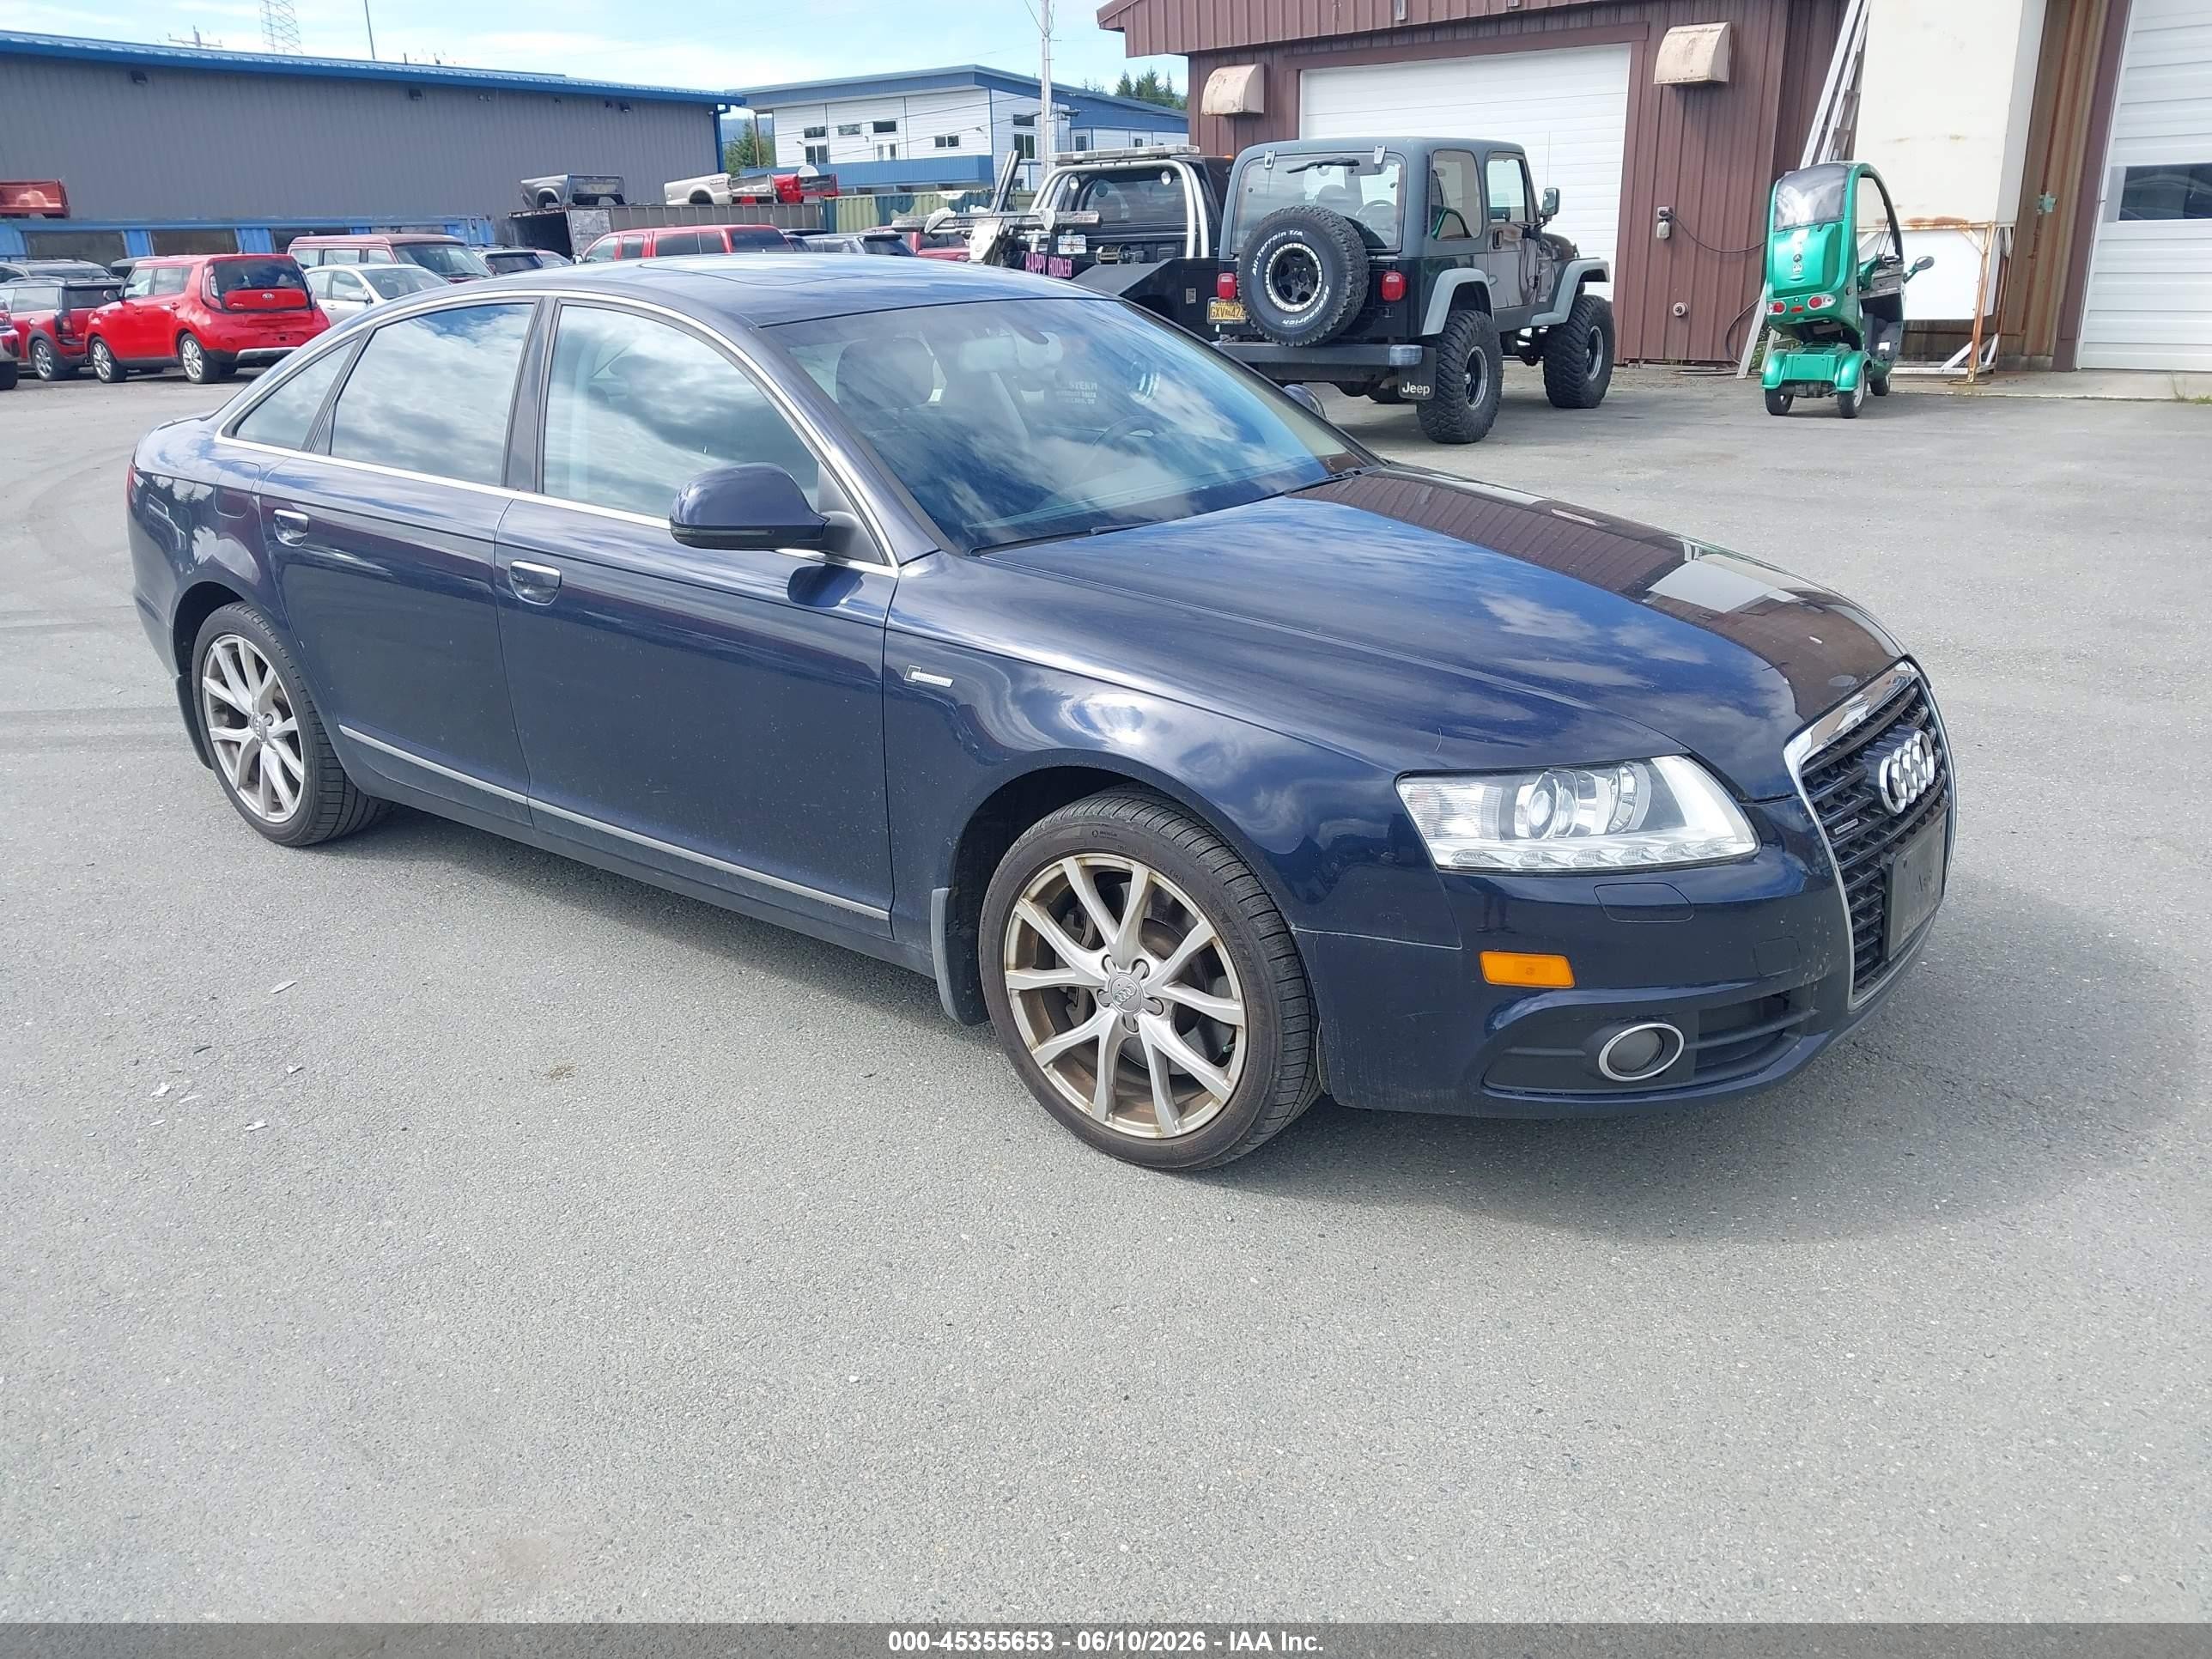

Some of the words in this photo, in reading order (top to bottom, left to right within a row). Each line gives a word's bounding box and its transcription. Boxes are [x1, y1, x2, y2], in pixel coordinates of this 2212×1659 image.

[1025, 252, 1047, 275] HAPPY
[1048, 255, 1073, 277] HOOKER
[1252, 231, 1287, 276] All-Terrain
[1401, 381, 1431, 397] Jeep
